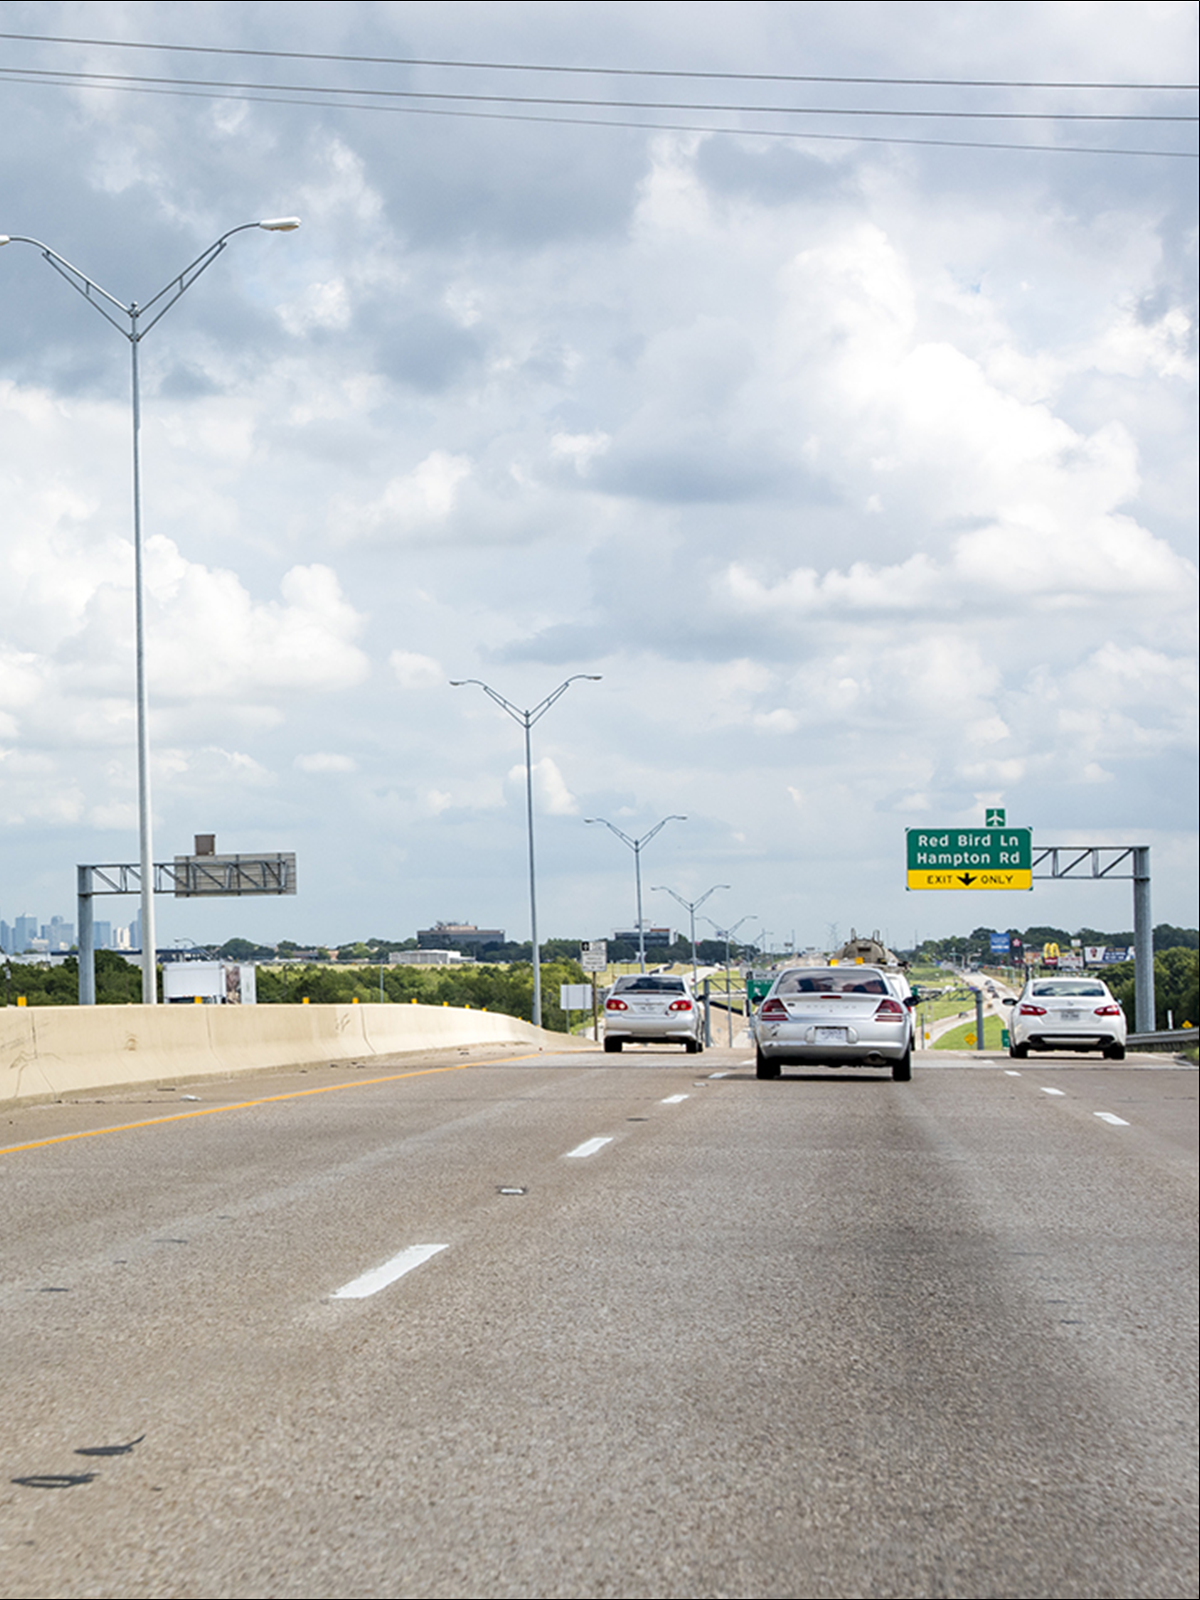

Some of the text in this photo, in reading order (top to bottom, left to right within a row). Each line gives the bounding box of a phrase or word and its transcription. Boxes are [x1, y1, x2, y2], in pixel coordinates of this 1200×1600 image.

[918, 834, 1019, 847] Red Bird Ln
[917, 851, 1020, 867] Hampton Rd
[926, 874, 1013, 884] EXIT ONLY
